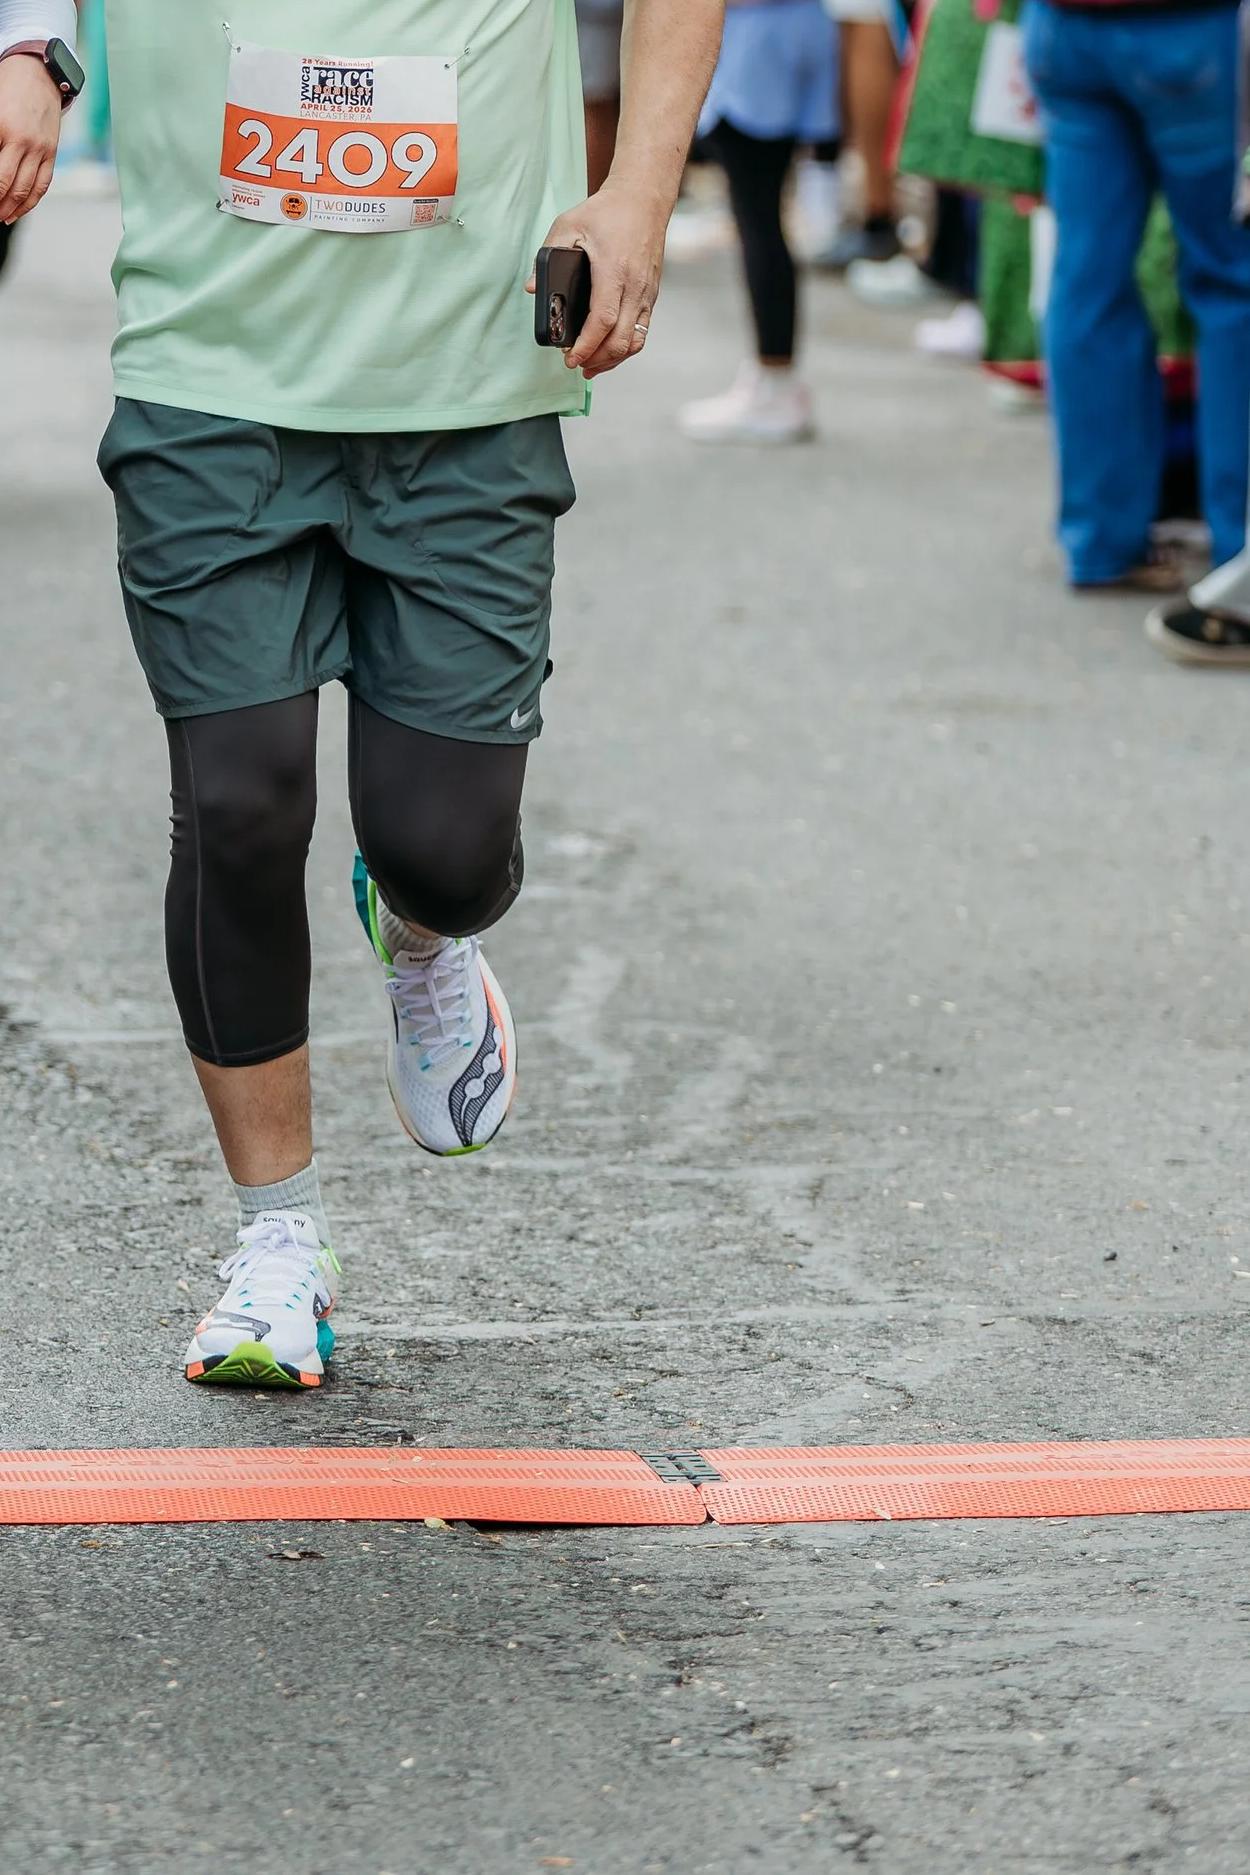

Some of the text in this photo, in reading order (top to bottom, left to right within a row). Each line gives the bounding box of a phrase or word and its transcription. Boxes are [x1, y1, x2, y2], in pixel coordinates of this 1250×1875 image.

[338, 61, 374, 69] Running!
[301, 66, 312, 101] ywca
[312, 70, 374, 88] race
[312, 92, 373, 106] RACISM
[300, 103, 328, 111] APRIL
[330, 105, 345, 113] 25,
[360, 113, 372, 121] PA
[234, 118, 438, 189] 2409
[232, 192, 260, 206] ywca
